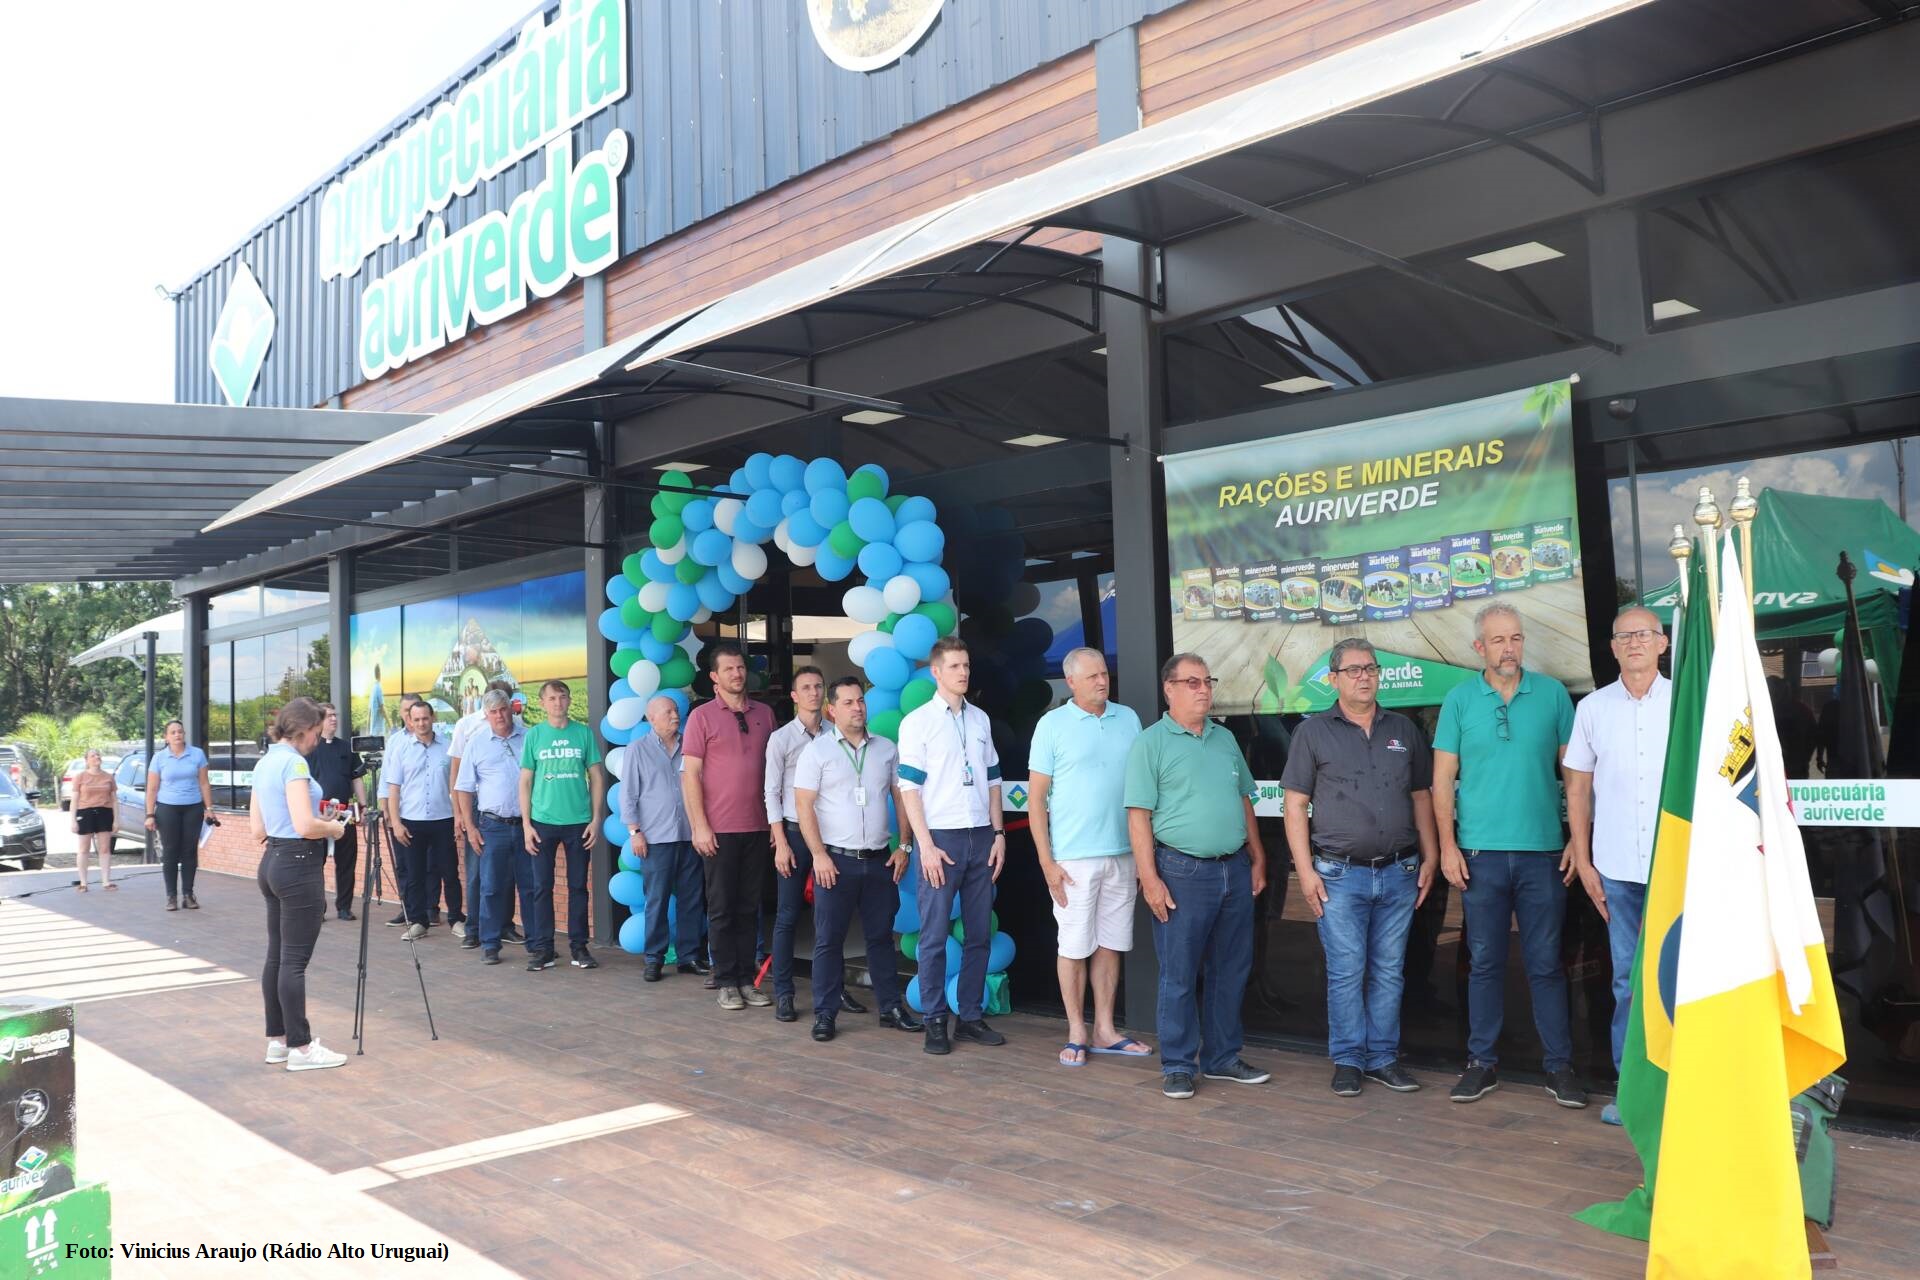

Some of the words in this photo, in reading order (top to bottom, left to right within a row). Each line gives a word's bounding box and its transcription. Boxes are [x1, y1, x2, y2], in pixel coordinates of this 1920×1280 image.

[322, 0, 623, 274] agropecuária
[1219, 470, 1328, 508] RAÇÕES
[1336, 465, 1353, 490] E
[1361, 439, 1505, 486] MINERAIS
[1275, 482, 1440, 528] AURIVERDE
[1391, 680, 1424, 689] ANIMAL
[538, 748, 583, 760] CLUBE
[551, 739, 570, 747] APP
